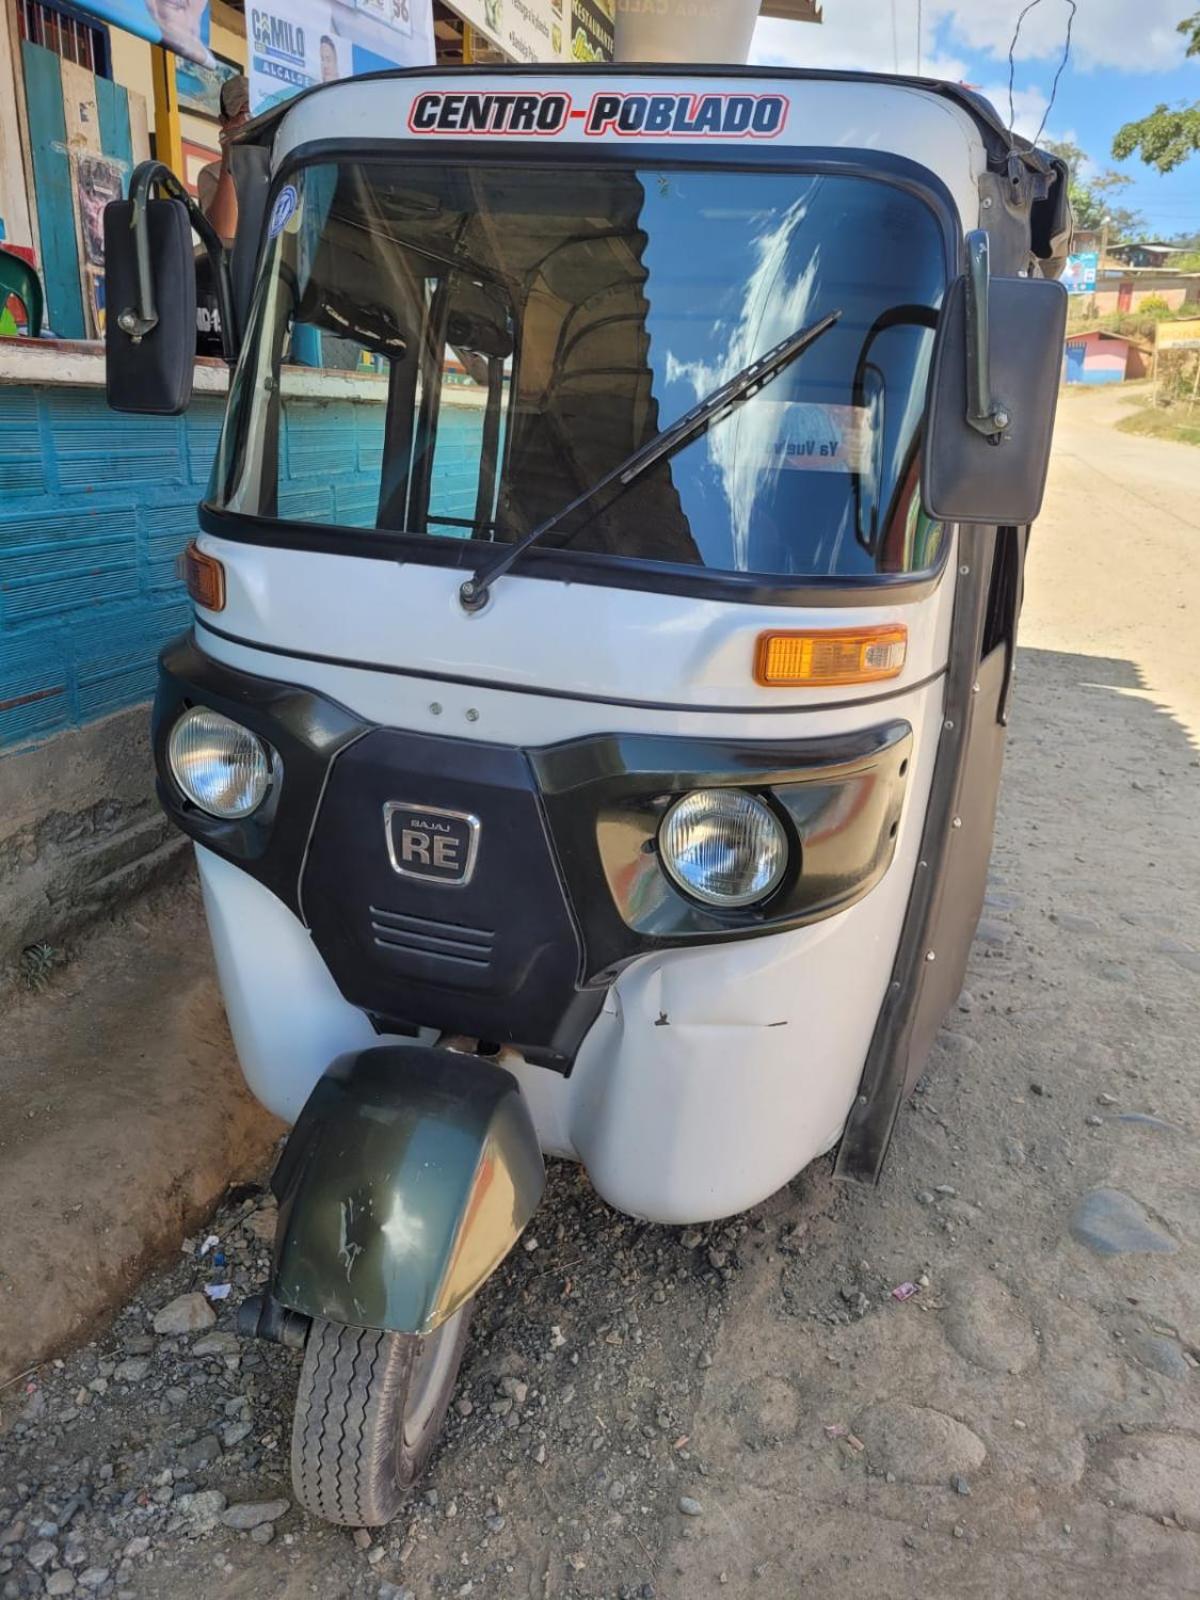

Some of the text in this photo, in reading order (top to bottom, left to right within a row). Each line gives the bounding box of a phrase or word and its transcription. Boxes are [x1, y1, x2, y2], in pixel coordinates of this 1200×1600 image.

[251, 8, 305, 58] CAMILO
[411, 819, 450, 832] BAJAJ
[402, 829, 459, 869] RE
